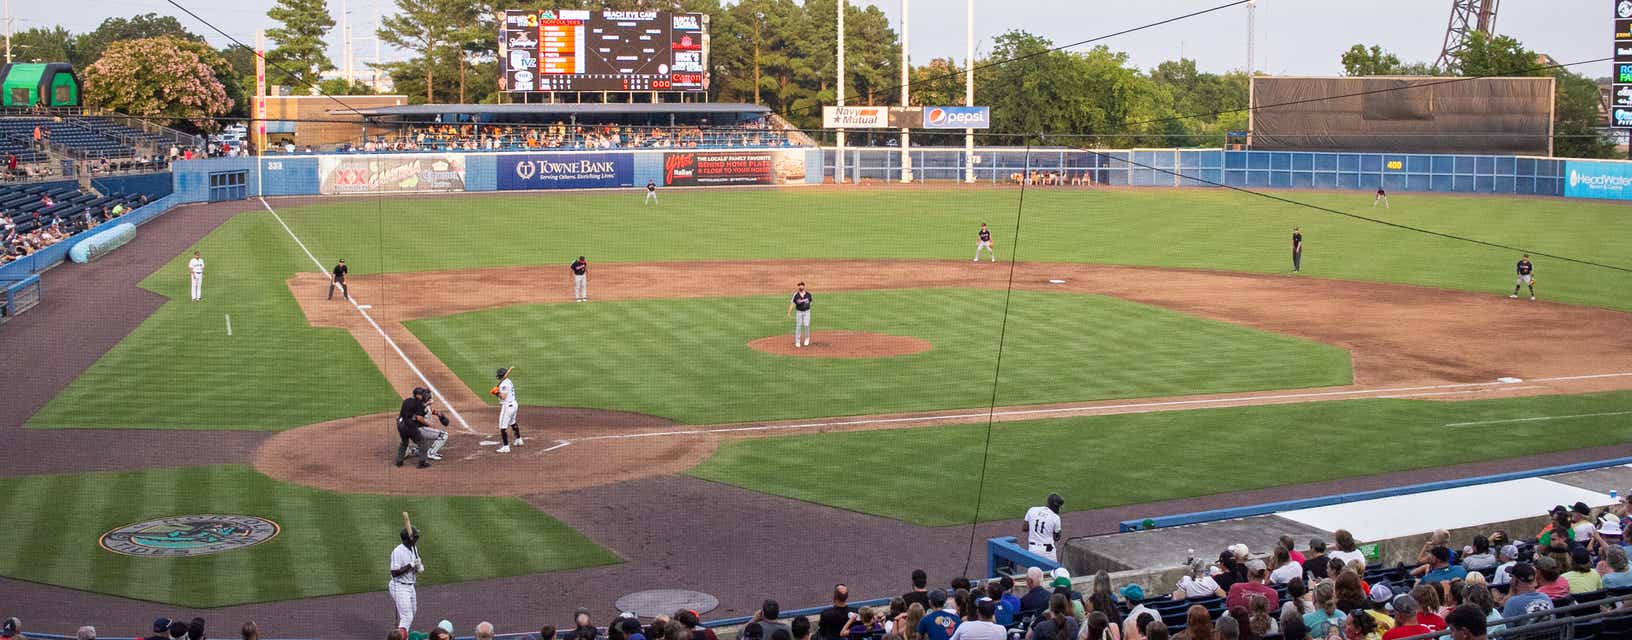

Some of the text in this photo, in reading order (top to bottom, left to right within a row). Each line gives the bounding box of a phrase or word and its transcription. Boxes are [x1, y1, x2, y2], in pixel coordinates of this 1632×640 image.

[528, 14, 537, 28] 3
[673, 74, 701, 82] Canon
[836, 108, 858, 117] Navy
[948, 112, 984, 124] pepsi
[843, 116, 878, 124] Mutual
[538, 160, 614, 174] TOWNE BANK
[1387, 160, 1402, 170] 400
[1035, 520, 1045, 534] 11
